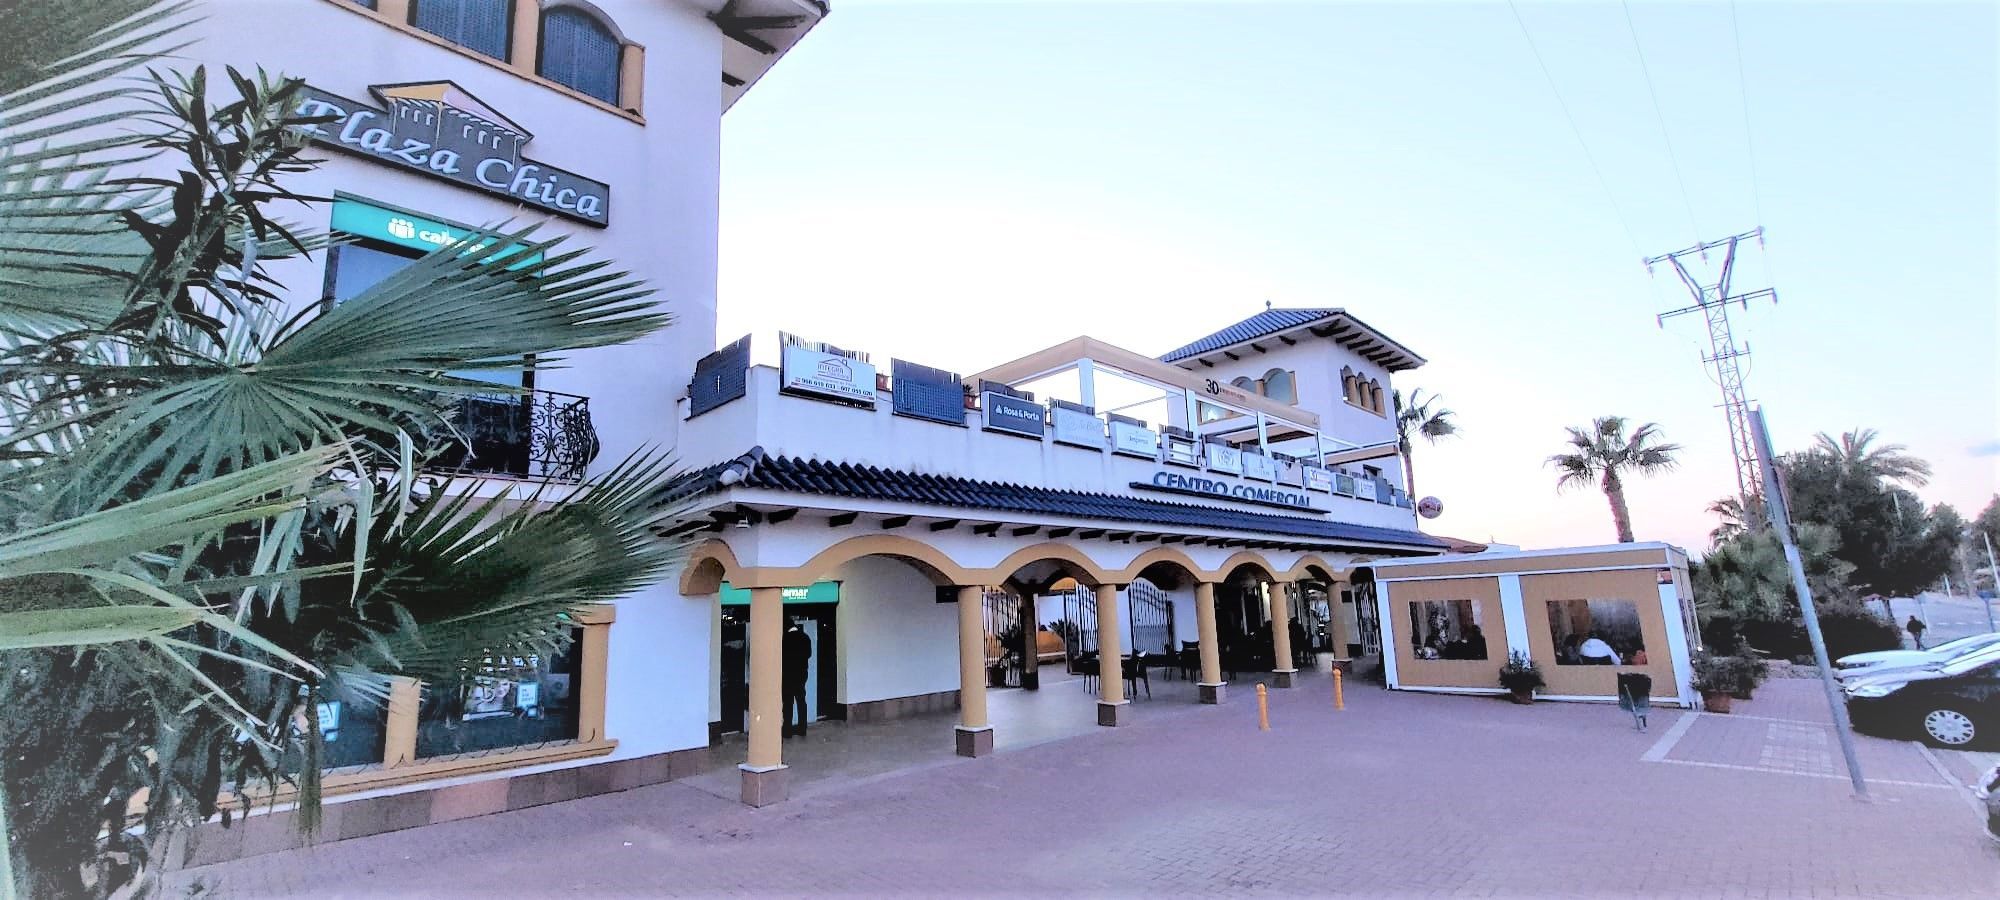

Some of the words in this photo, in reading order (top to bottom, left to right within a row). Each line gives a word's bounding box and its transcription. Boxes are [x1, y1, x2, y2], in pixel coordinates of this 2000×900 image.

[291, 97, 460, 174] Plaza
[476, 158, 601, 217] Chica
[1003, 406, 1018, 417] Rosa
[1018, 409, 1023, 418] &
[1023, 410, 1040, 421] Porta
[1153, 471, 1228, 495] CENTRO
[1232, 485, 1310, 507] COMERCIAL
